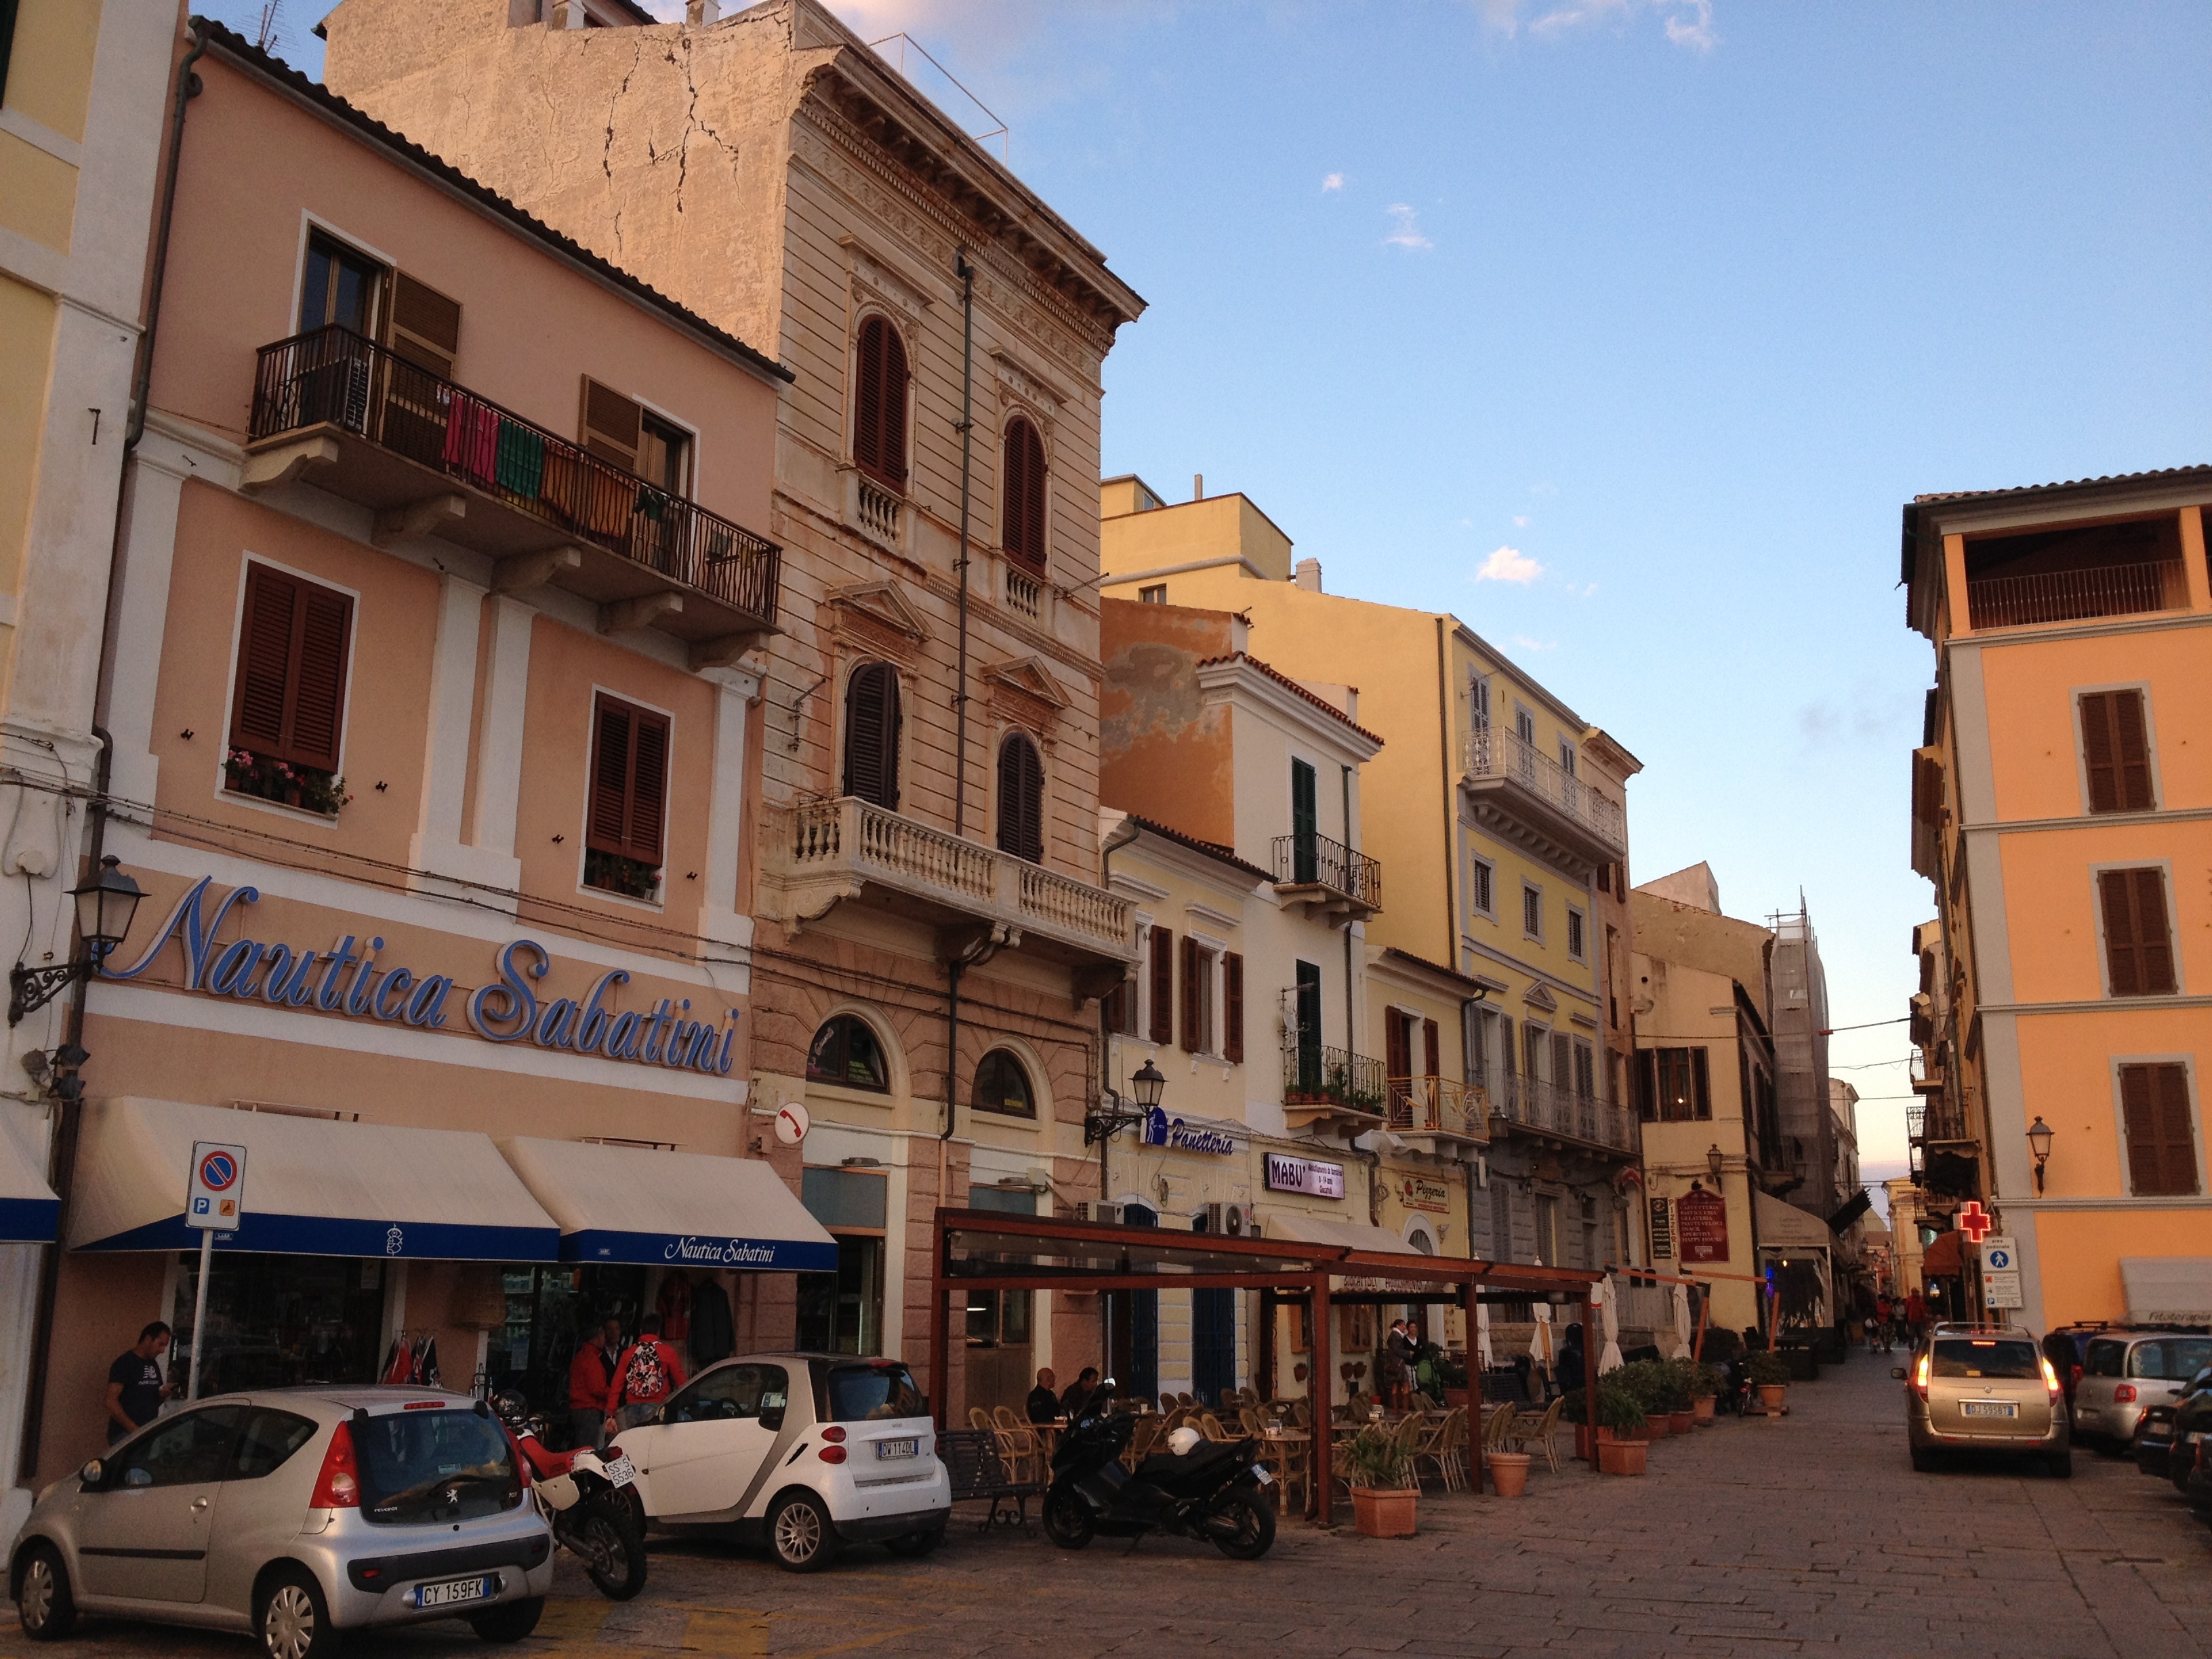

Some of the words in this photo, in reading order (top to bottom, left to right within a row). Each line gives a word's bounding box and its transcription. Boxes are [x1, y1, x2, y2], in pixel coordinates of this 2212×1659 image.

[91, 875, 453, 1029] Nautica
[466, 939, 739, 1075] Sabatini
[1170, 1118, 1234, 1155] Panetteria
[1271, 1160, 1306, 1187] MABU'
[1416, 1179, 1446, 1200] Pizzeria
[197, 1199, 207, 1212] P
[1668, 1198, 1678, 1258] PIZZERIA
[664, 1236, 721, 1260] Nautica
[722, 1239, 776, 1263] Sabatini
[609, 1463, 619, 1475] SS
[613, 1469, 634, 1485] 5536
[424, 1586, 440, 1604] CY
[446, 1579, 482, 1601] 159FK
